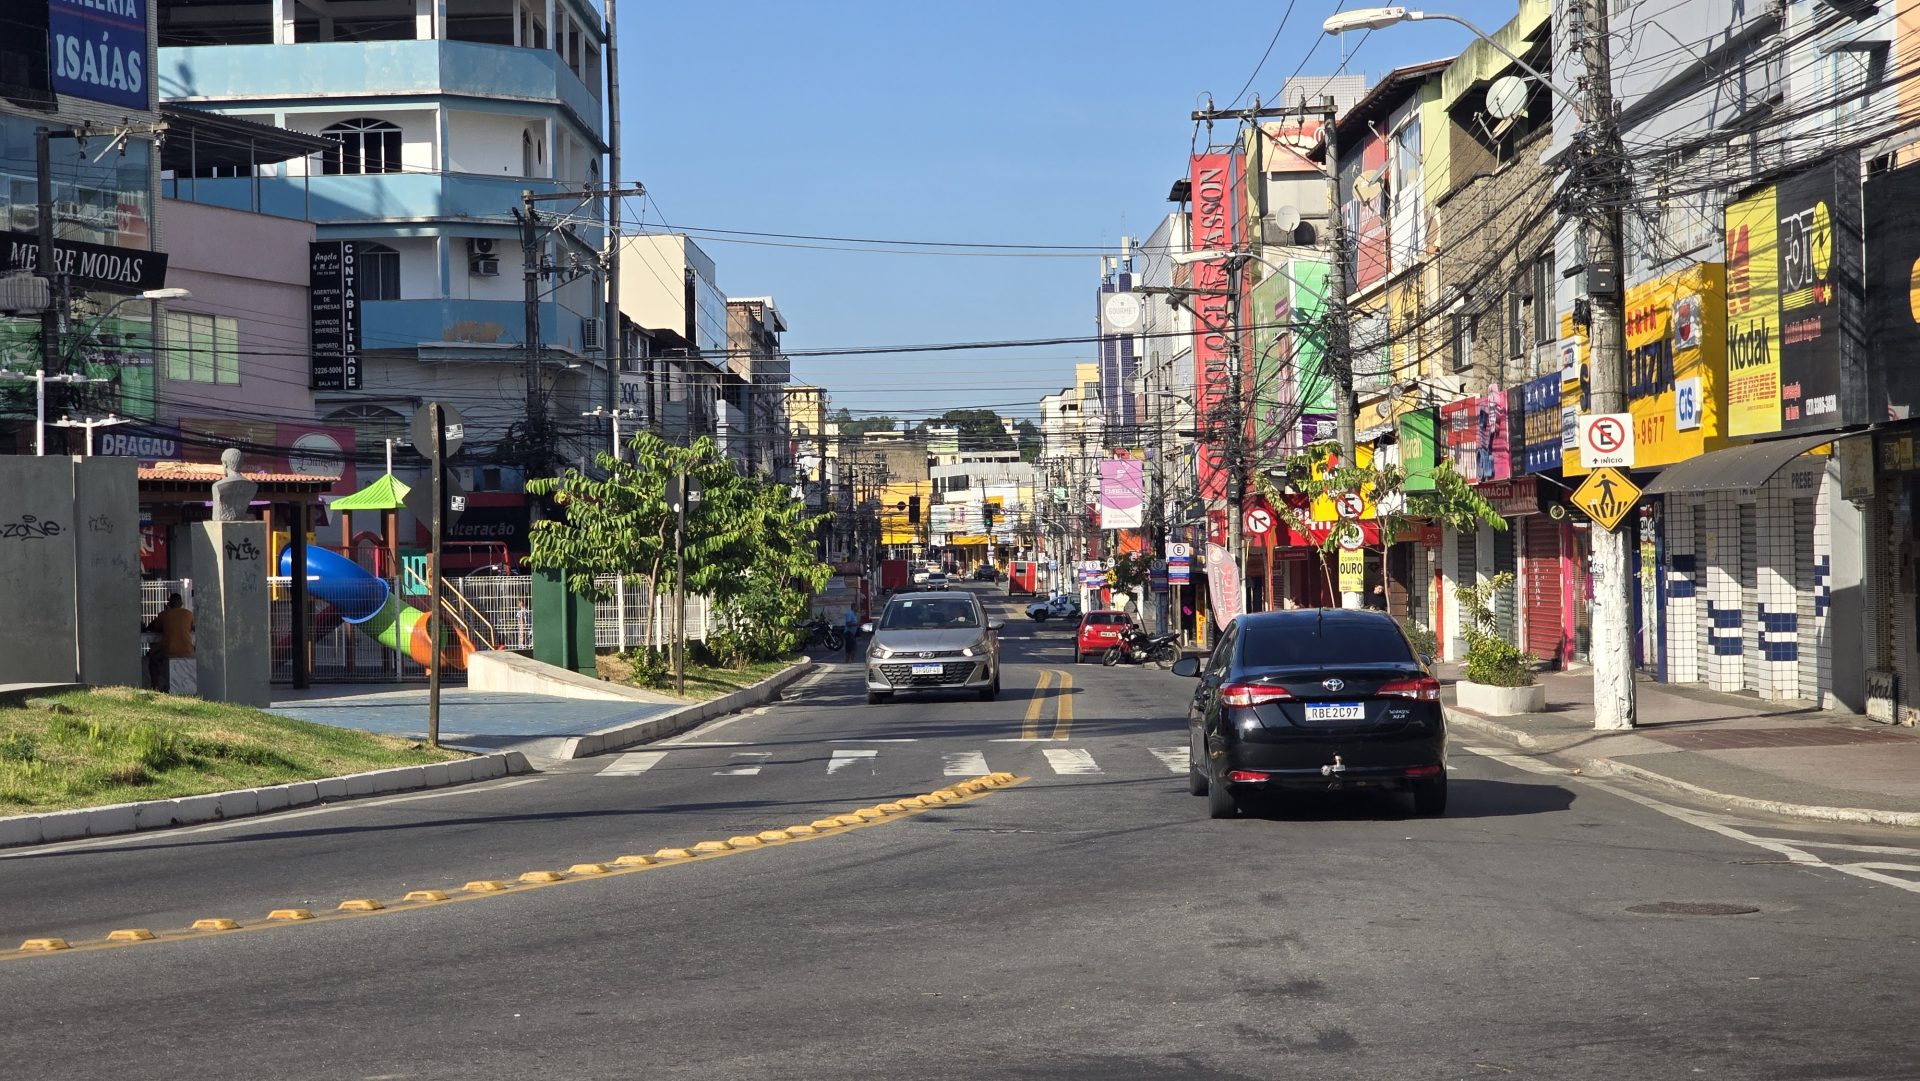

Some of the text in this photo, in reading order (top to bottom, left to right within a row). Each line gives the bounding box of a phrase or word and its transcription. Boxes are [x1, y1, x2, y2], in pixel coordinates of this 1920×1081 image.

[56, 31, 141, 93] ISAÍAS
[1199, 167, 1226, 257] ASSON
[80, 251, 143, 284] MODAS
[344, 244, 357, 387] CONTABILIDADE
[1729, 316, 1772, 371] Kodak
[1728, 371, 1777, 406] EXPRESS
[1600, 424, 1613, 446] E
[1600, 456, 1623, 464] INÍCIO
[1176, 546, 1182, 554] E
[1339, 562, 1363, 575] OURO
[1311, 707, 1359, 719] RBE2C97
